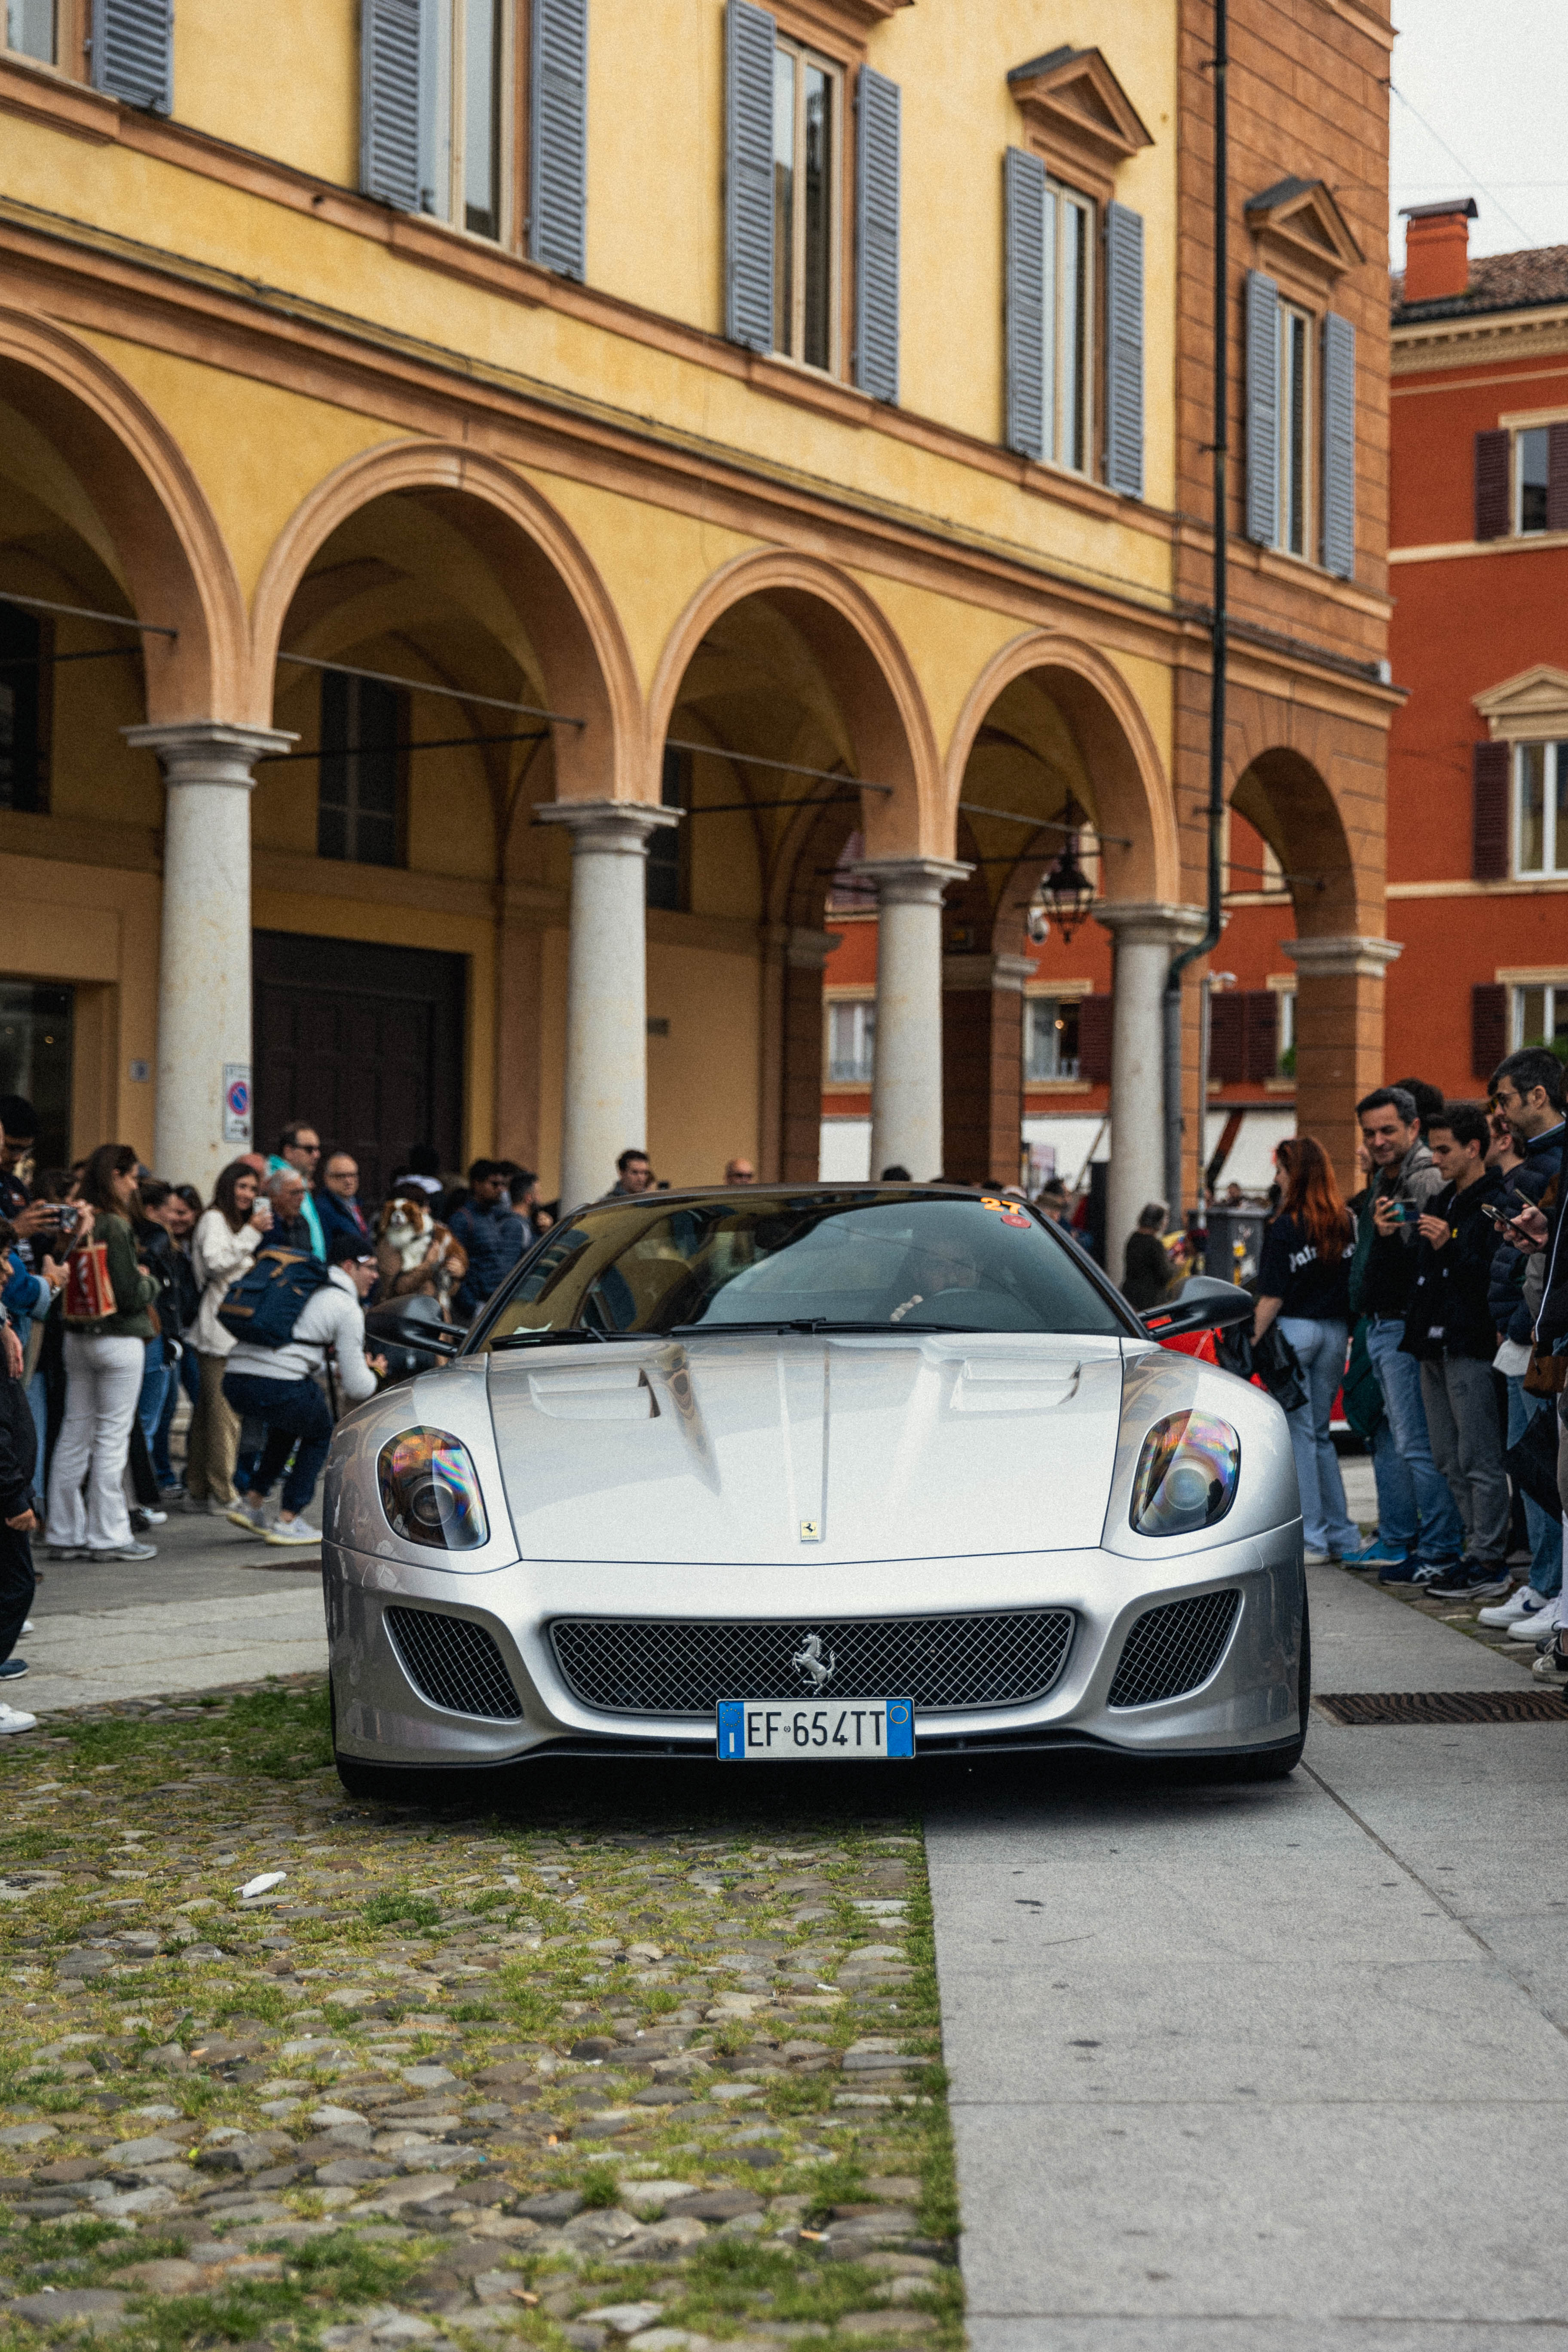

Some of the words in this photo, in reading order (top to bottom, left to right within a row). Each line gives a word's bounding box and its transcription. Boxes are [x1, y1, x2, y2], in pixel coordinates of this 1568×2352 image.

[980, 1197, 1021, 1214] 27
[747, 1712, 781, 1747] EF
[793, 1710, 885, 1746] 654TT
[729, 1732, 735, 1753] I
